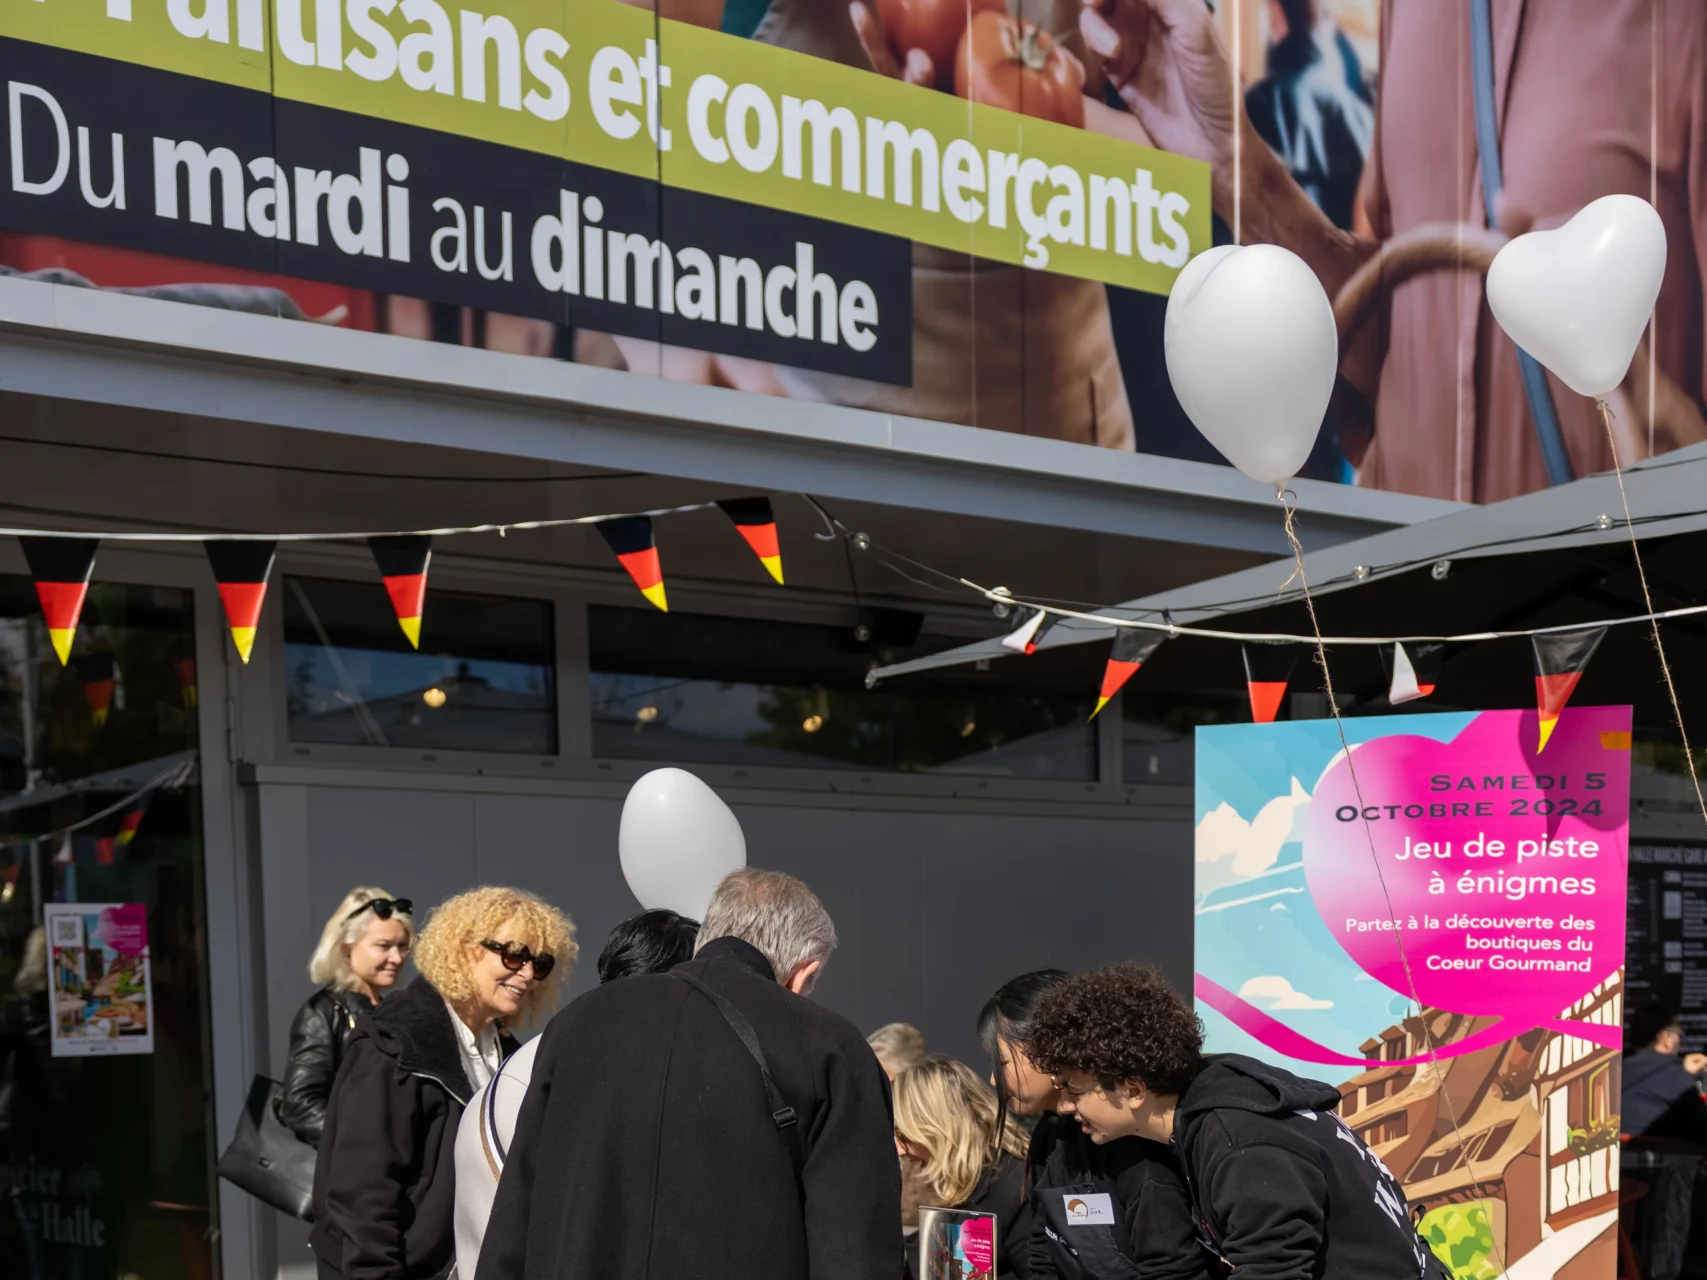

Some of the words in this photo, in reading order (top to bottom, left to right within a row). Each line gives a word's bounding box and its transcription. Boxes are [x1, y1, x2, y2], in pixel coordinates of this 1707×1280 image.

[588, 40, 673, 152] et
[686, 73, 1191, 270] commerçants
[7, 80, 127, 211] Du
[153, 136, 411, 263] mardi
[430, 197, 515, 282] au
[531, 189, 880, 352] dimanche
[1584, 773, 1606, 791] 5
[1335, 801, 1494, 822] OCTOBRE
[1509, 799, 1604, 817] 2024
[1395, 836, 1451, 860] Jeu
[1463, 832, 1506, 858] de
[1517, 833, 1600, 863] piste
[1428, 870, 1445, 894] à
[1457, 870, 1596, 900] énigmes
[1346, 917, 1402, 932] Partez
[1408, 915, 1418, 930] à
[1424, 914, 1440, 929] la
[1445, 914, 1554, 929] découverte
[1560, 914, 1595, 930] des
[1466, 934, 1562, 953] boutiques
[1568, 936, 1593, 951] du
[1426, 955, 1484, 970] Coeur
[1488, 955, 1592, 972] Gourmand
